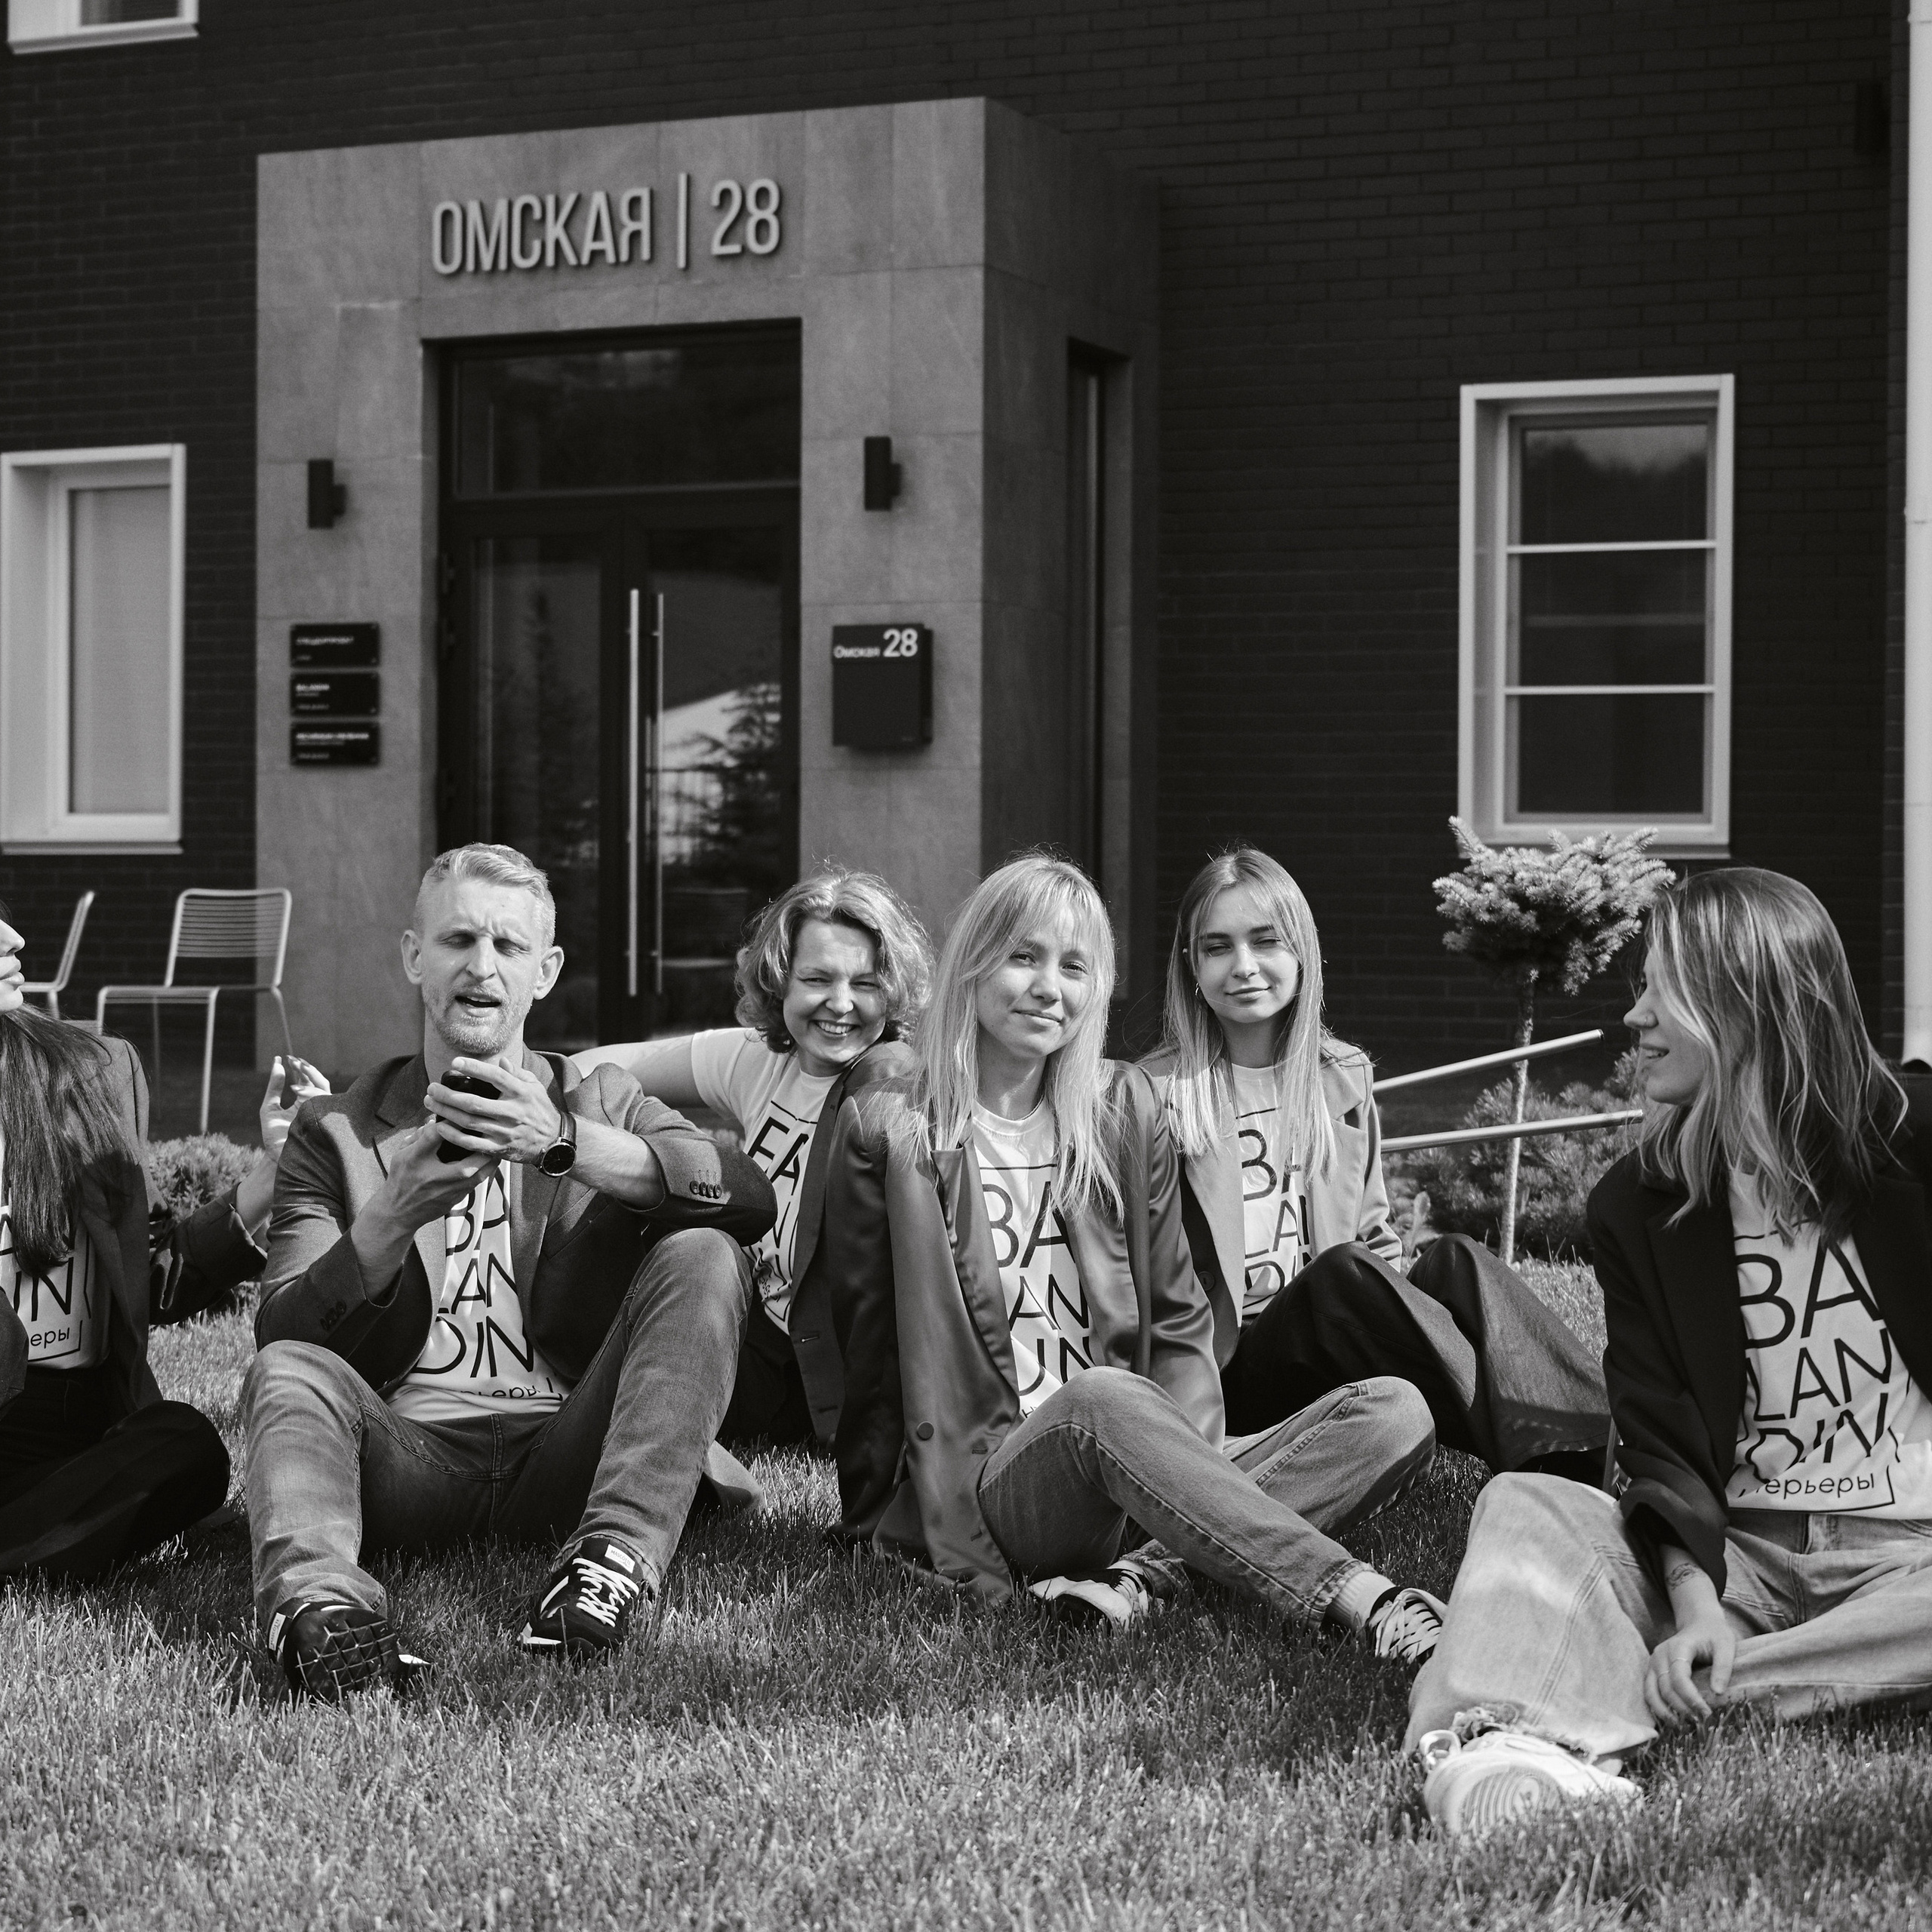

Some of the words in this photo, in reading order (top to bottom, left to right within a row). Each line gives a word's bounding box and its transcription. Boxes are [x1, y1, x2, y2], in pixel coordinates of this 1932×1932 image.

[432, 186, 651, 275] ОМСКАЯ
[710, 178, 780, 256] 28
[883, 628, 918, 657] 28
[983, 1181, 1076, 1269] BA
[1736, 1236, 1884, 1350] BA
[1756, 1472, 1875, 1500] ерьеры
